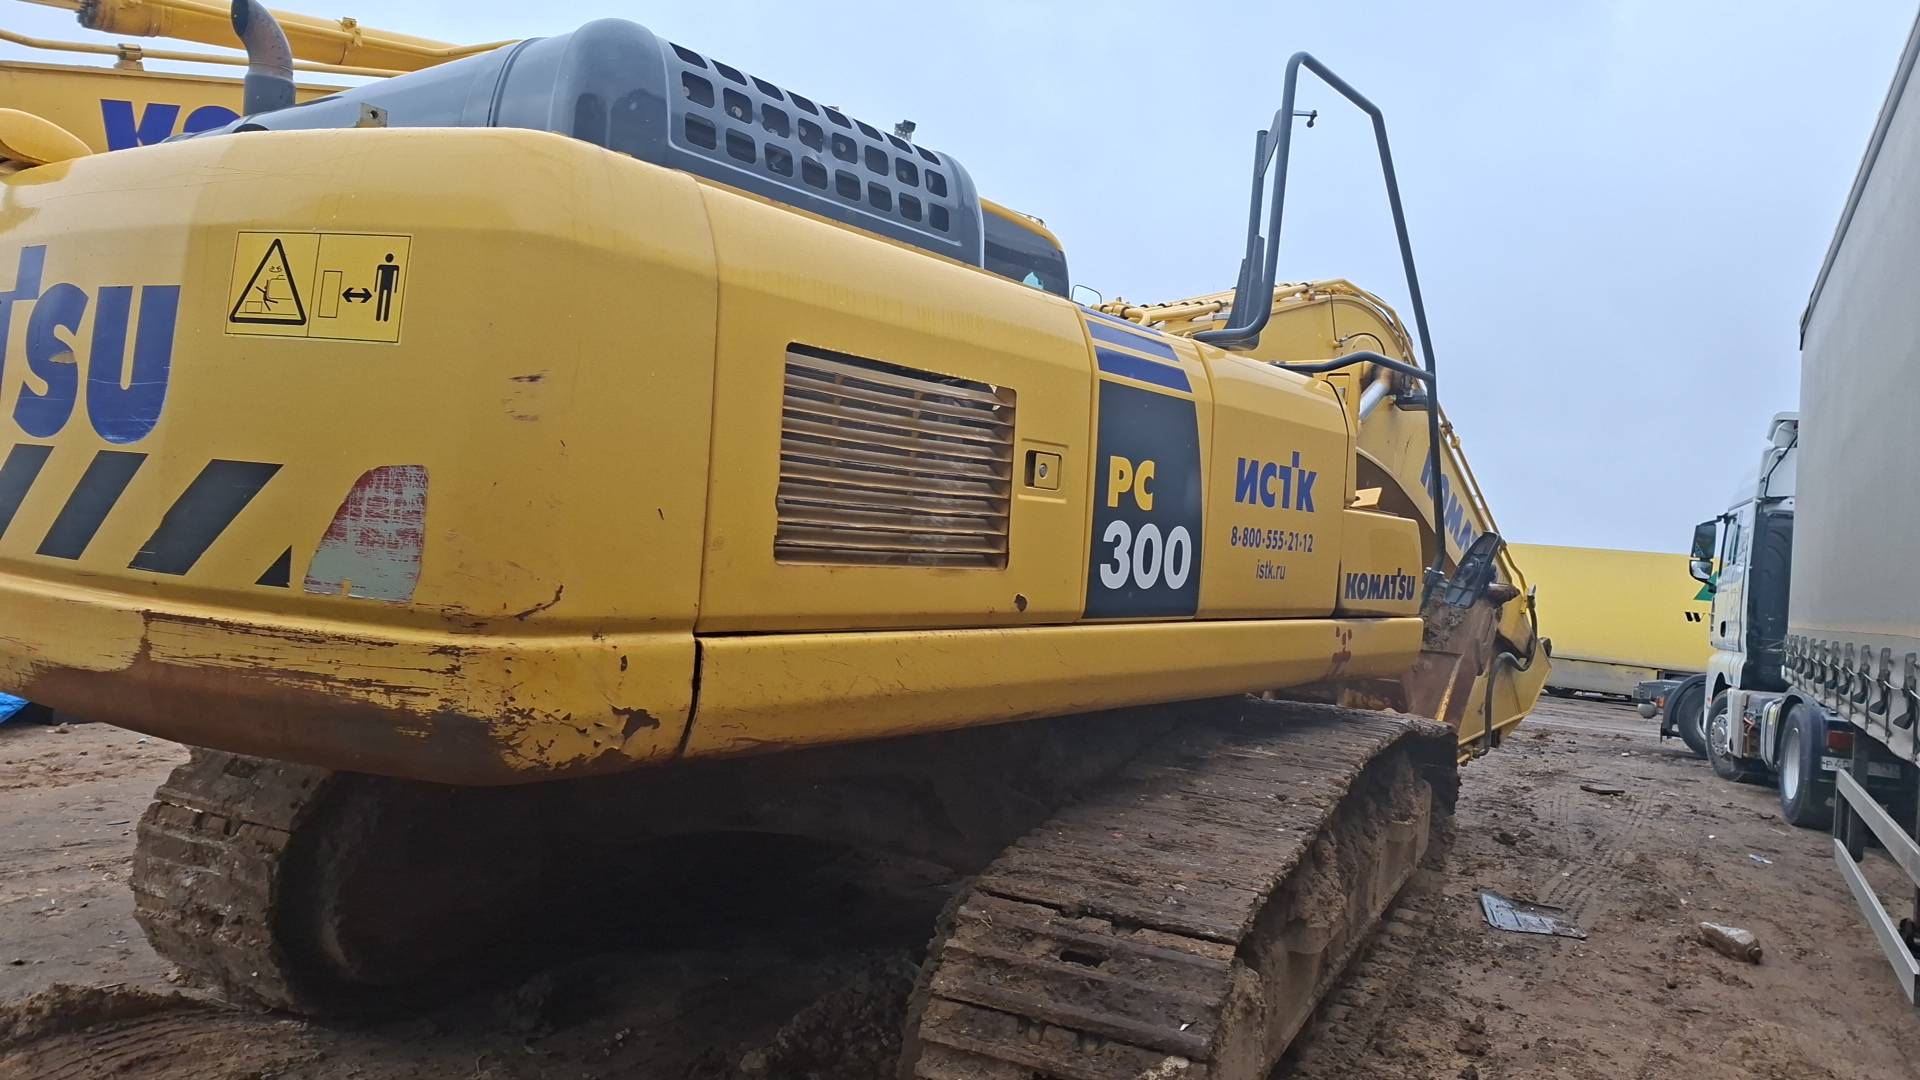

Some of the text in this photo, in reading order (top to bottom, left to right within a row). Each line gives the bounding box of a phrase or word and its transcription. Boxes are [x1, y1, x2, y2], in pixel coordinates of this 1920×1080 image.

[1107, 455, 1155, 511] PC
[1235, 451, 1317, 512] ИСТК
[1100, 520, 1192, 589] 300
[1256, 559, 1286, 580] istk.ru
[1344, 568, 1416, 600] KOMATSU
